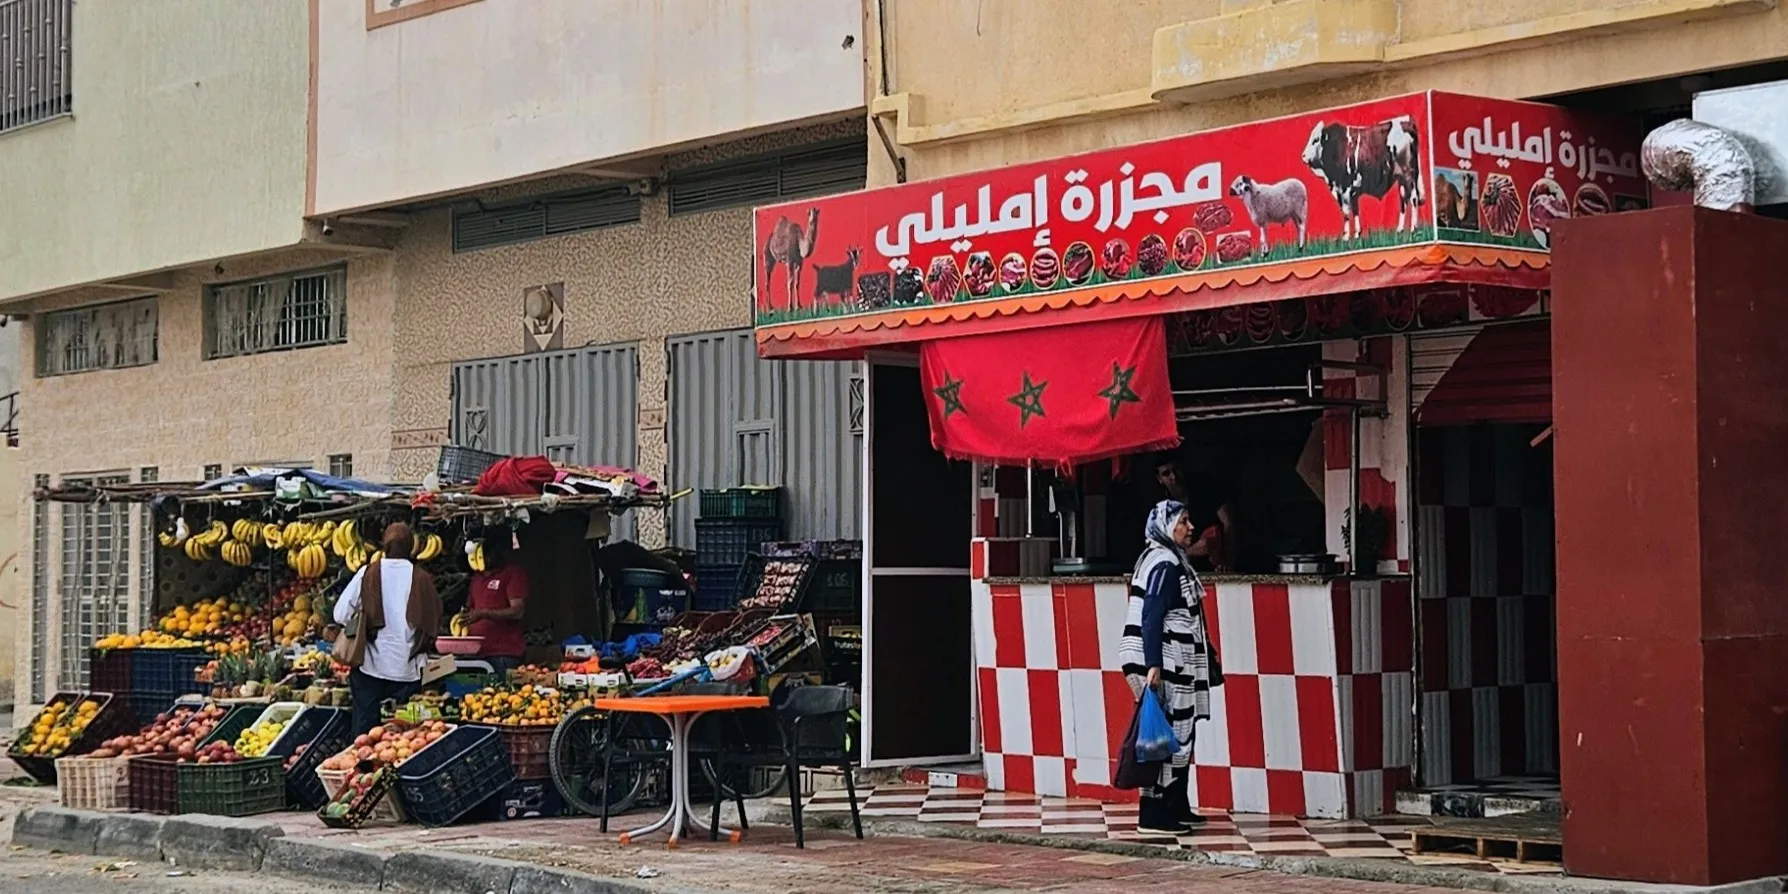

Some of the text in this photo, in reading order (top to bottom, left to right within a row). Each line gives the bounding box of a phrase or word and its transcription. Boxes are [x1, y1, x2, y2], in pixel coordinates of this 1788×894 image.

[1448, 115, 1639, 184] مجزرة إمليلي
[875, 161, 1222, 271] مجزرة إمليلي
